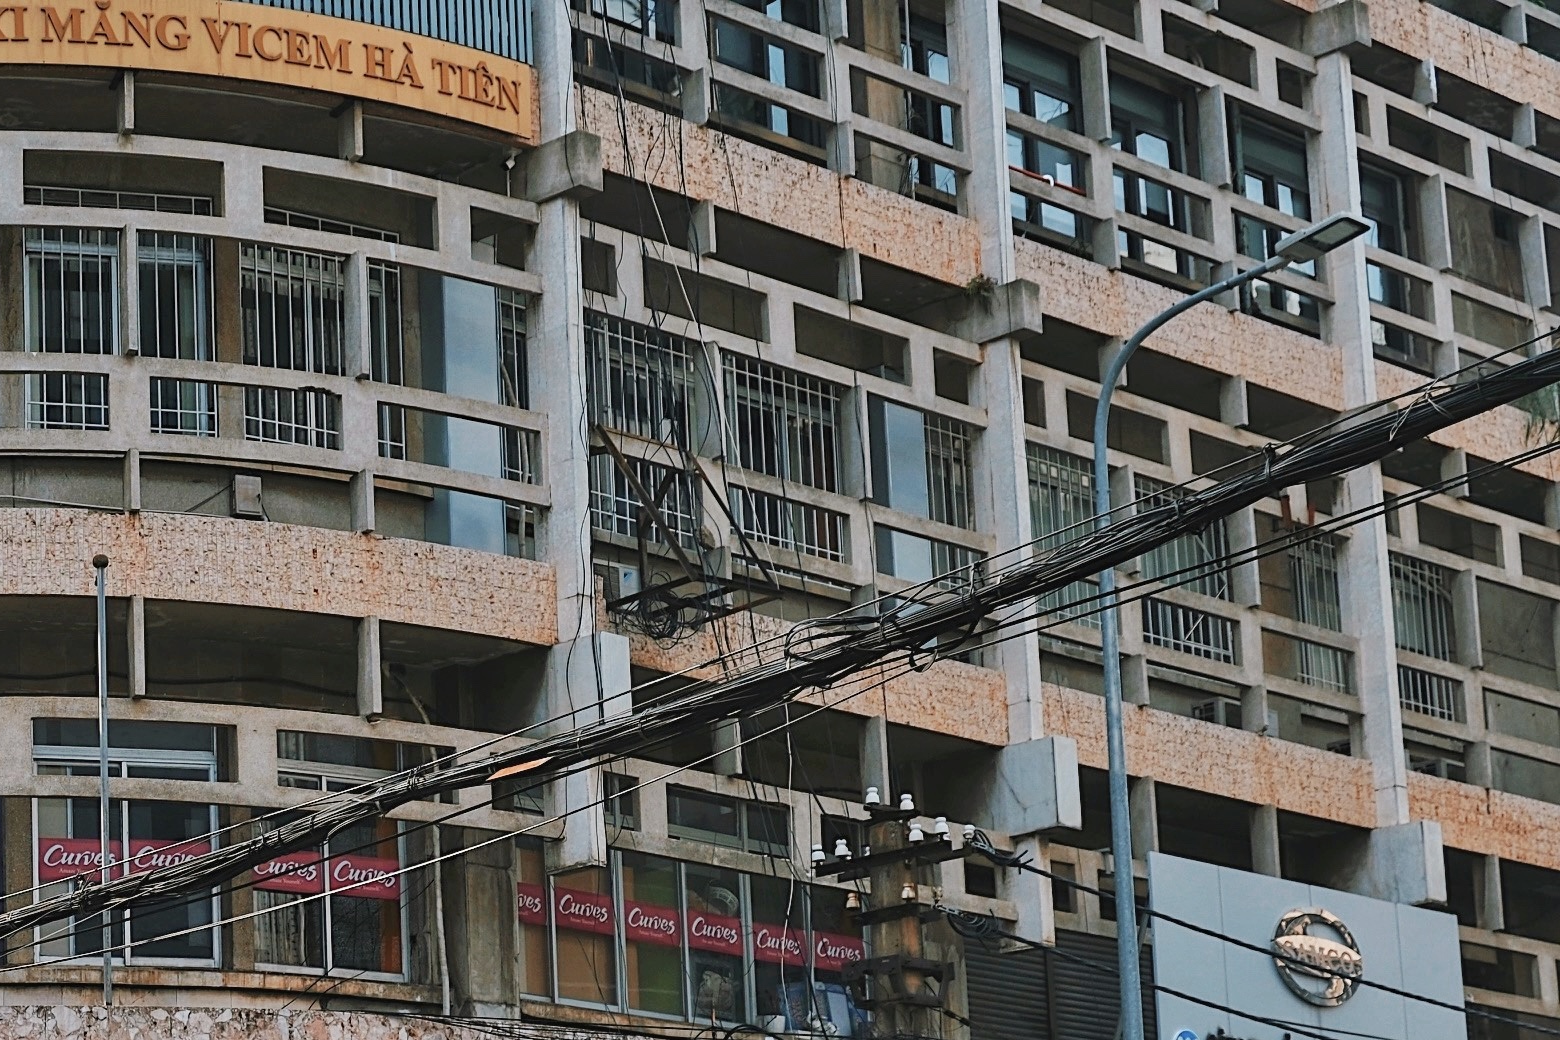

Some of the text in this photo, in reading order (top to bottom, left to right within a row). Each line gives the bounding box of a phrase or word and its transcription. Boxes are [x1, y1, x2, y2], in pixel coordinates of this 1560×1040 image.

[40, 0, 191, 51] MĂNG
[201, 17, 354, 74] VICEM
[363, 37, 425, 89] HÀ
[431, 57, 523, 116] TIÊN
[559, 894, 608, 923] Curves
[628, 907, 676, 935] Curves
[692, 917, 738, 944] Curves
[757, 929, 801, 955] Curves
[817, 938, 861, 962] Curves
